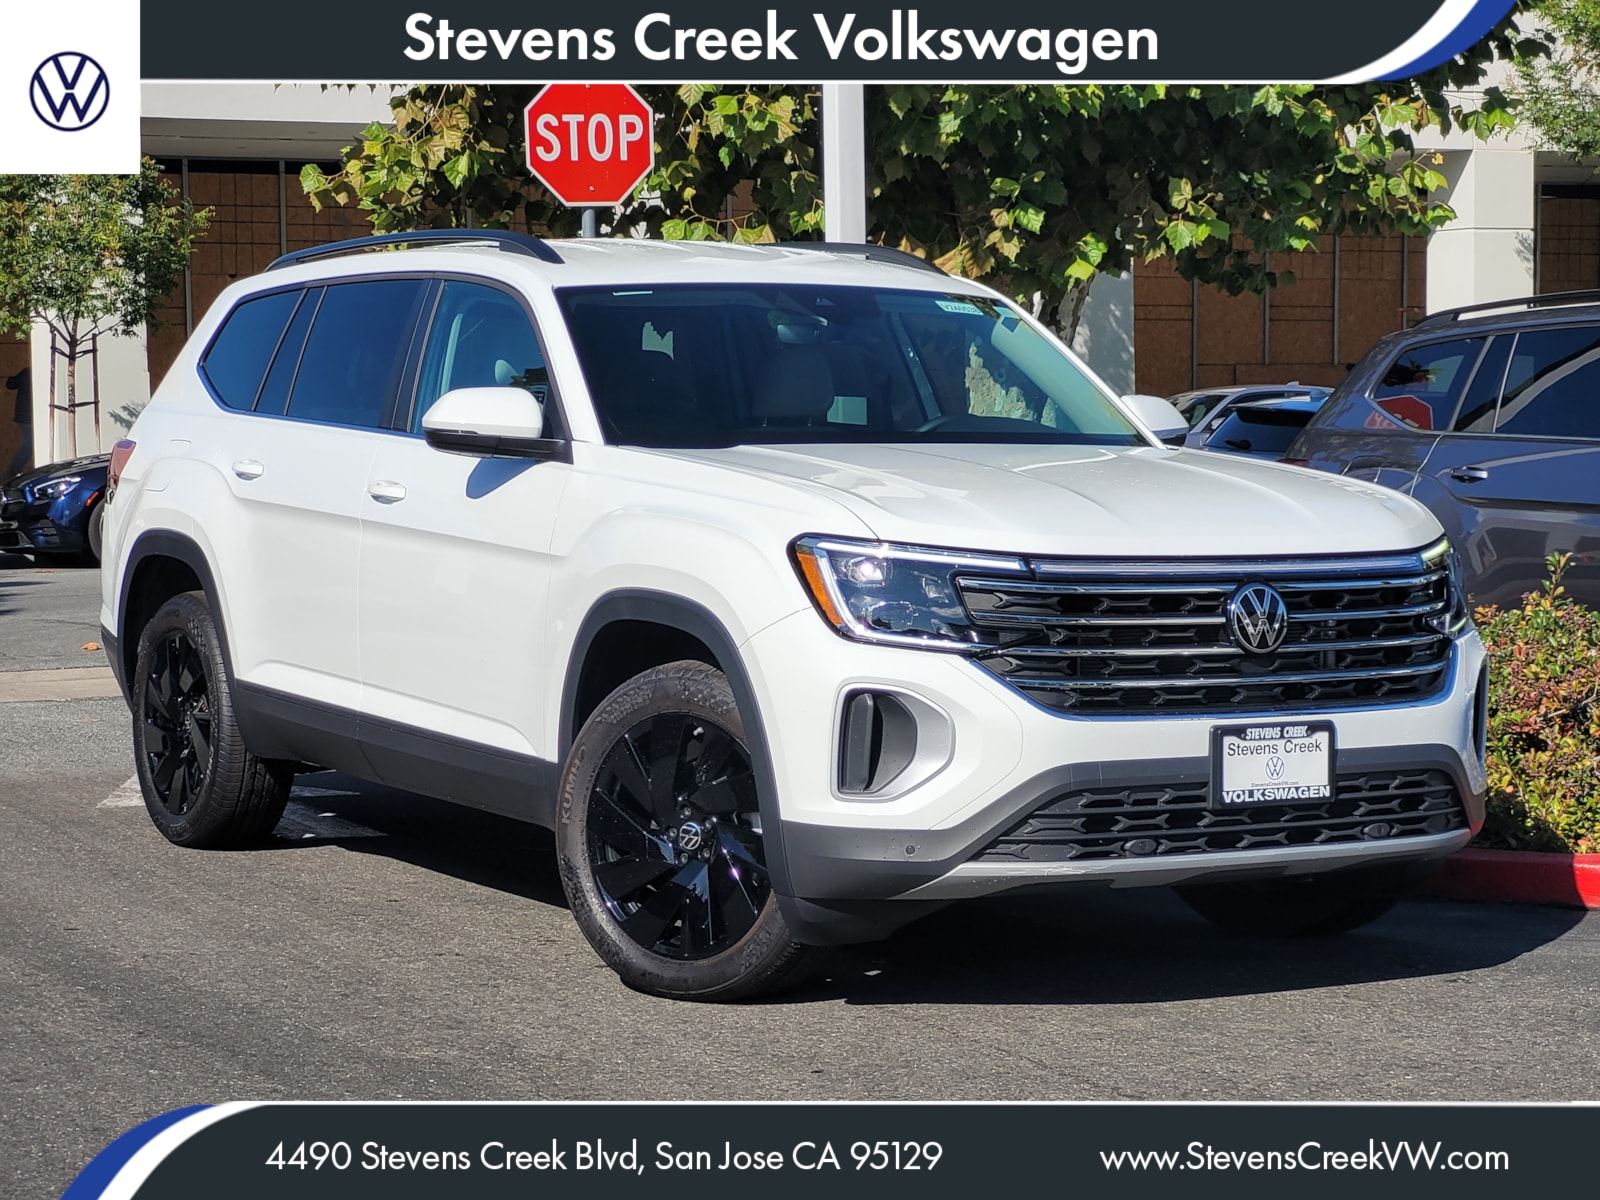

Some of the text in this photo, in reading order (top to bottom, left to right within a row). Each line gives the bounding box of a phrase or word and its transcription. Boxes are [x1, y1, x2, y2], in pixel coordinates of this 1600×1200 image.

[535, 112, 644, 162] STOP
[1245, 725, 1308, 740] STEVENS CREEK
[1227, 739, 1323, 757] Stevens Creek
[1222, 785, 1331, 804] VOLKSWAGEN
